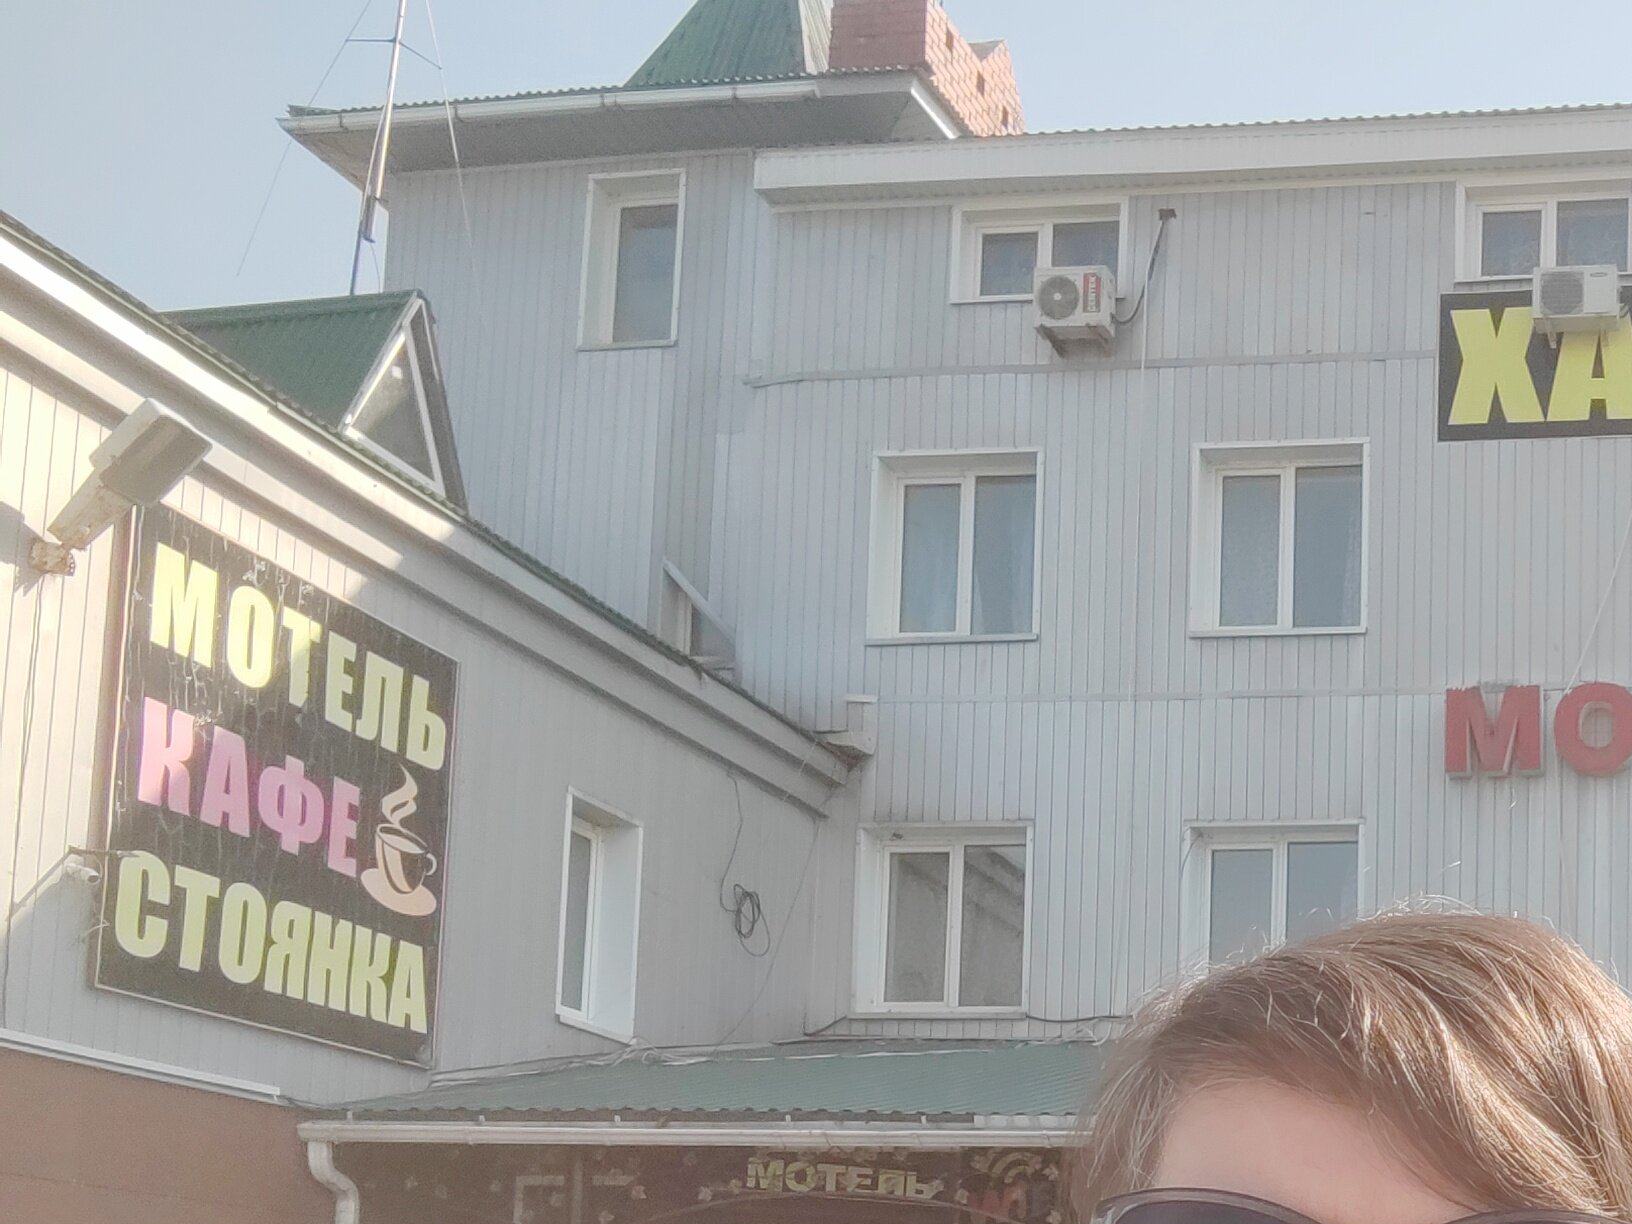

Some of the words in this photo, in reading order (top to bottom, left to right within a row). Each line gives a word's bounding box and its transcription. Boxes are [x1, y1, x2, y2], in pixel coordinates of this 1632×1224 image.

[149, 542, 447, 771] МОТЕЛЬ
[137, 696, 362, 878] КАФЕ
[114, 851, 428, 1034] СТОЯНКА
[746, 1157, 938, 1200] МОТЕЛЬ
